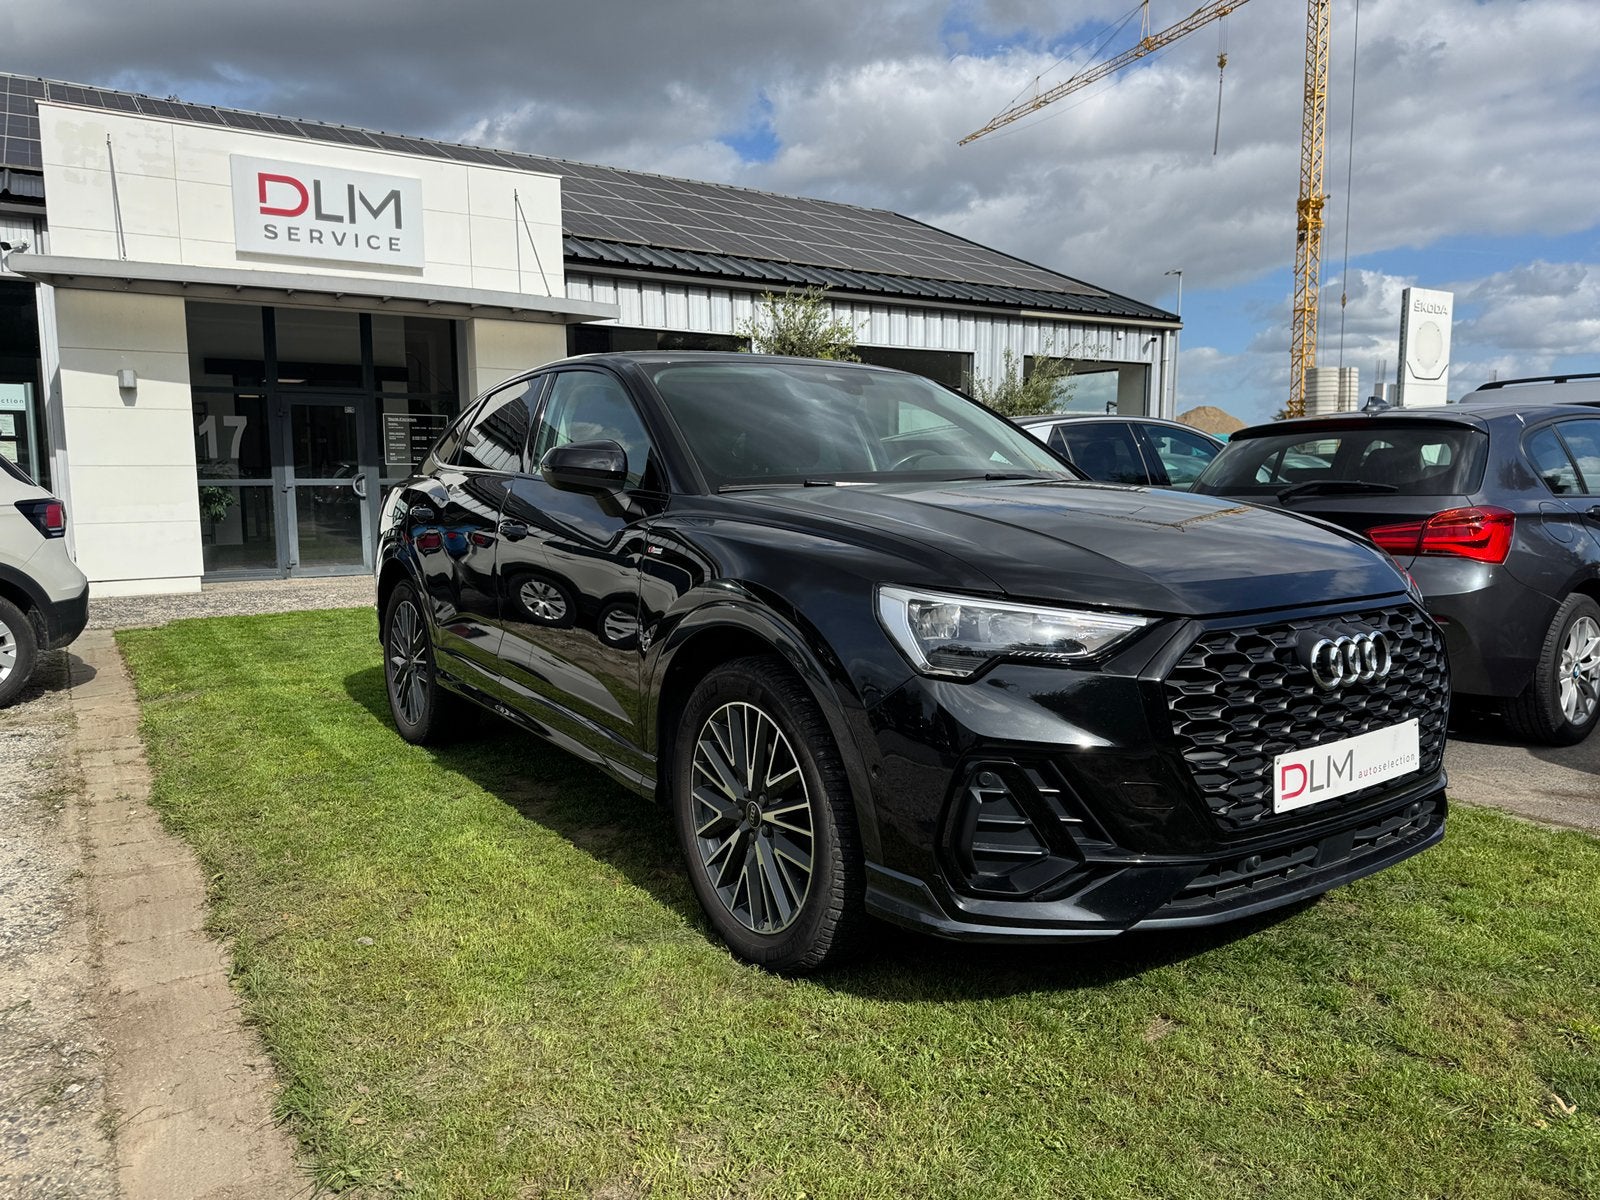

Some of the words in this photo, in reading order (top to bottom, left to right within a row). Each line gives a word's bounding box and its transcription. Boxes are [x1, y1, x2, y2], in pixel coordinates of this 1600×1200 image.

[257, 172, 402, 230] DLM
[263, 223, 401, 252] SERVICE
[198, 415, 247, 459] 17
[1281, 749, 1354, 801] DLM
[1358, 753, 1415, 779] autoselection
